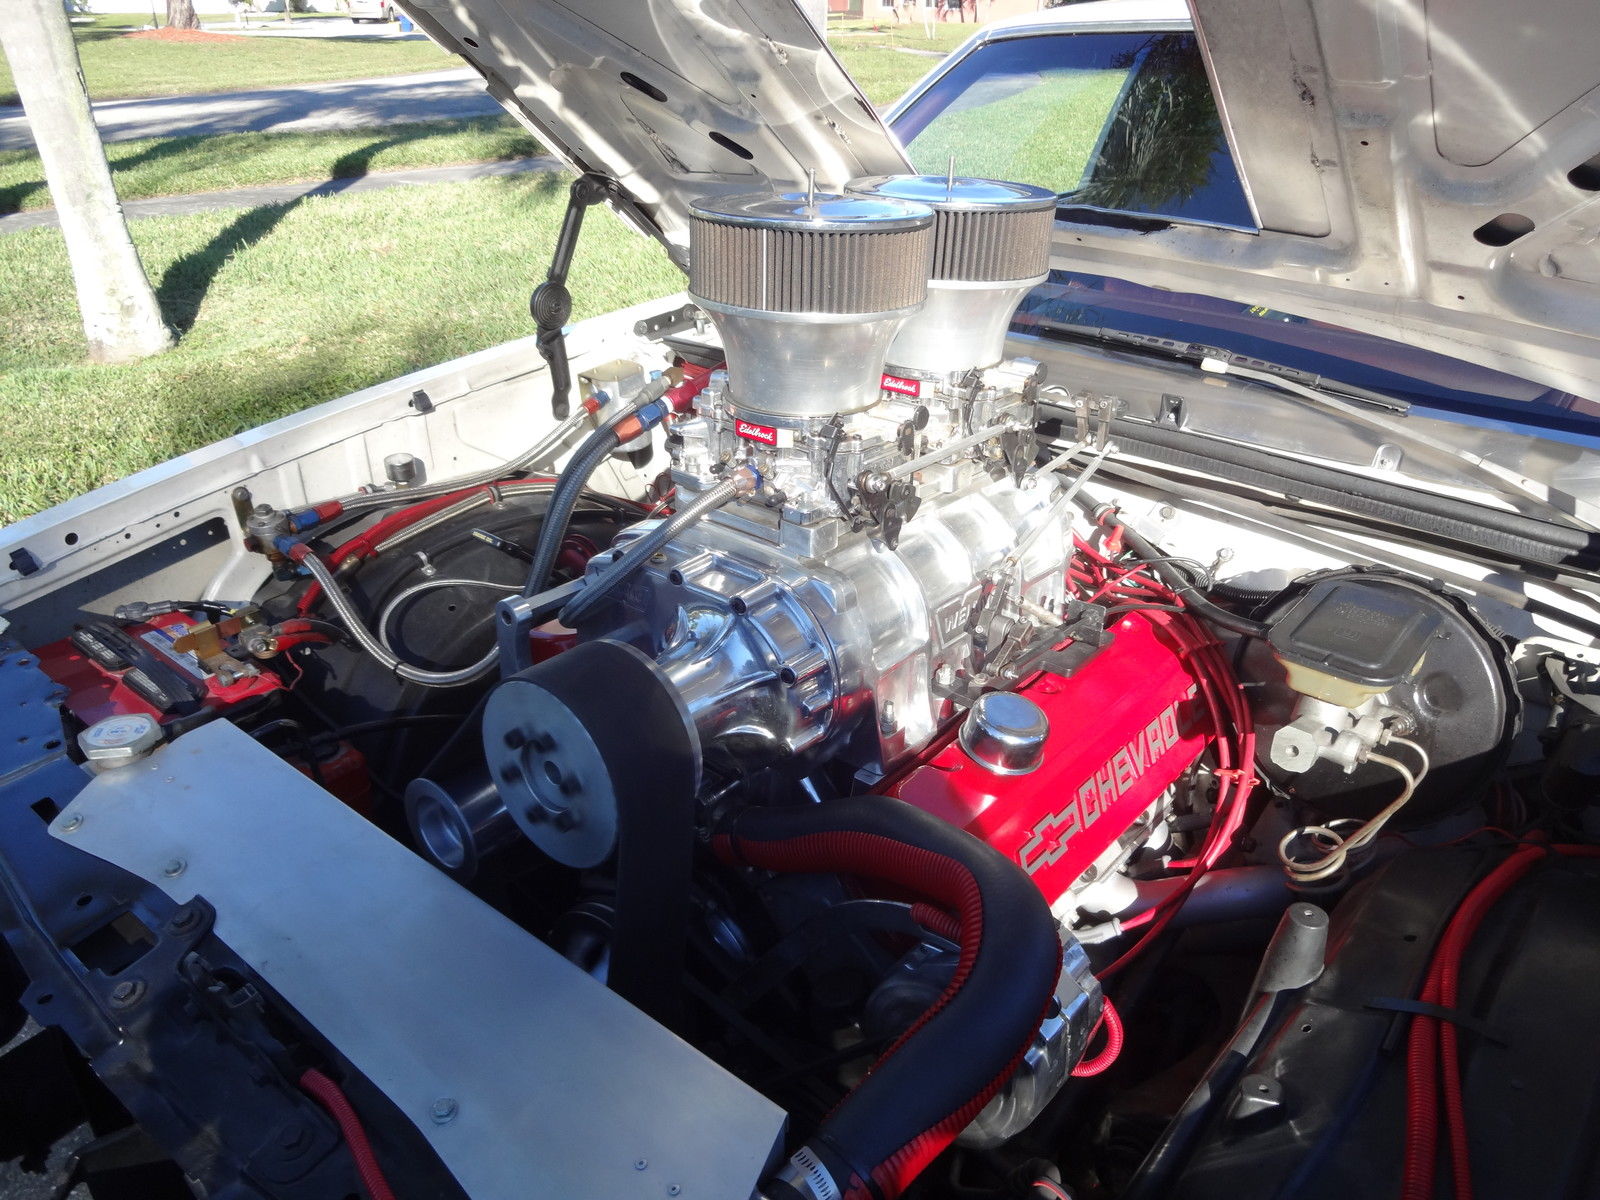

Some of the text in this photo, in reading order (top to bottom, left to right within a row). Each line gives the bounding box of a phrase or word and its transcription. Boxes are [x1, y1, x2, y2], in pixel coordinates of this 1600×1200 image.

[884, 378, 917, 393] Edelbrock
[739, 423, 774, 441] Edelbrock
[1078, 683, 1203, 829] CHEVROLE
